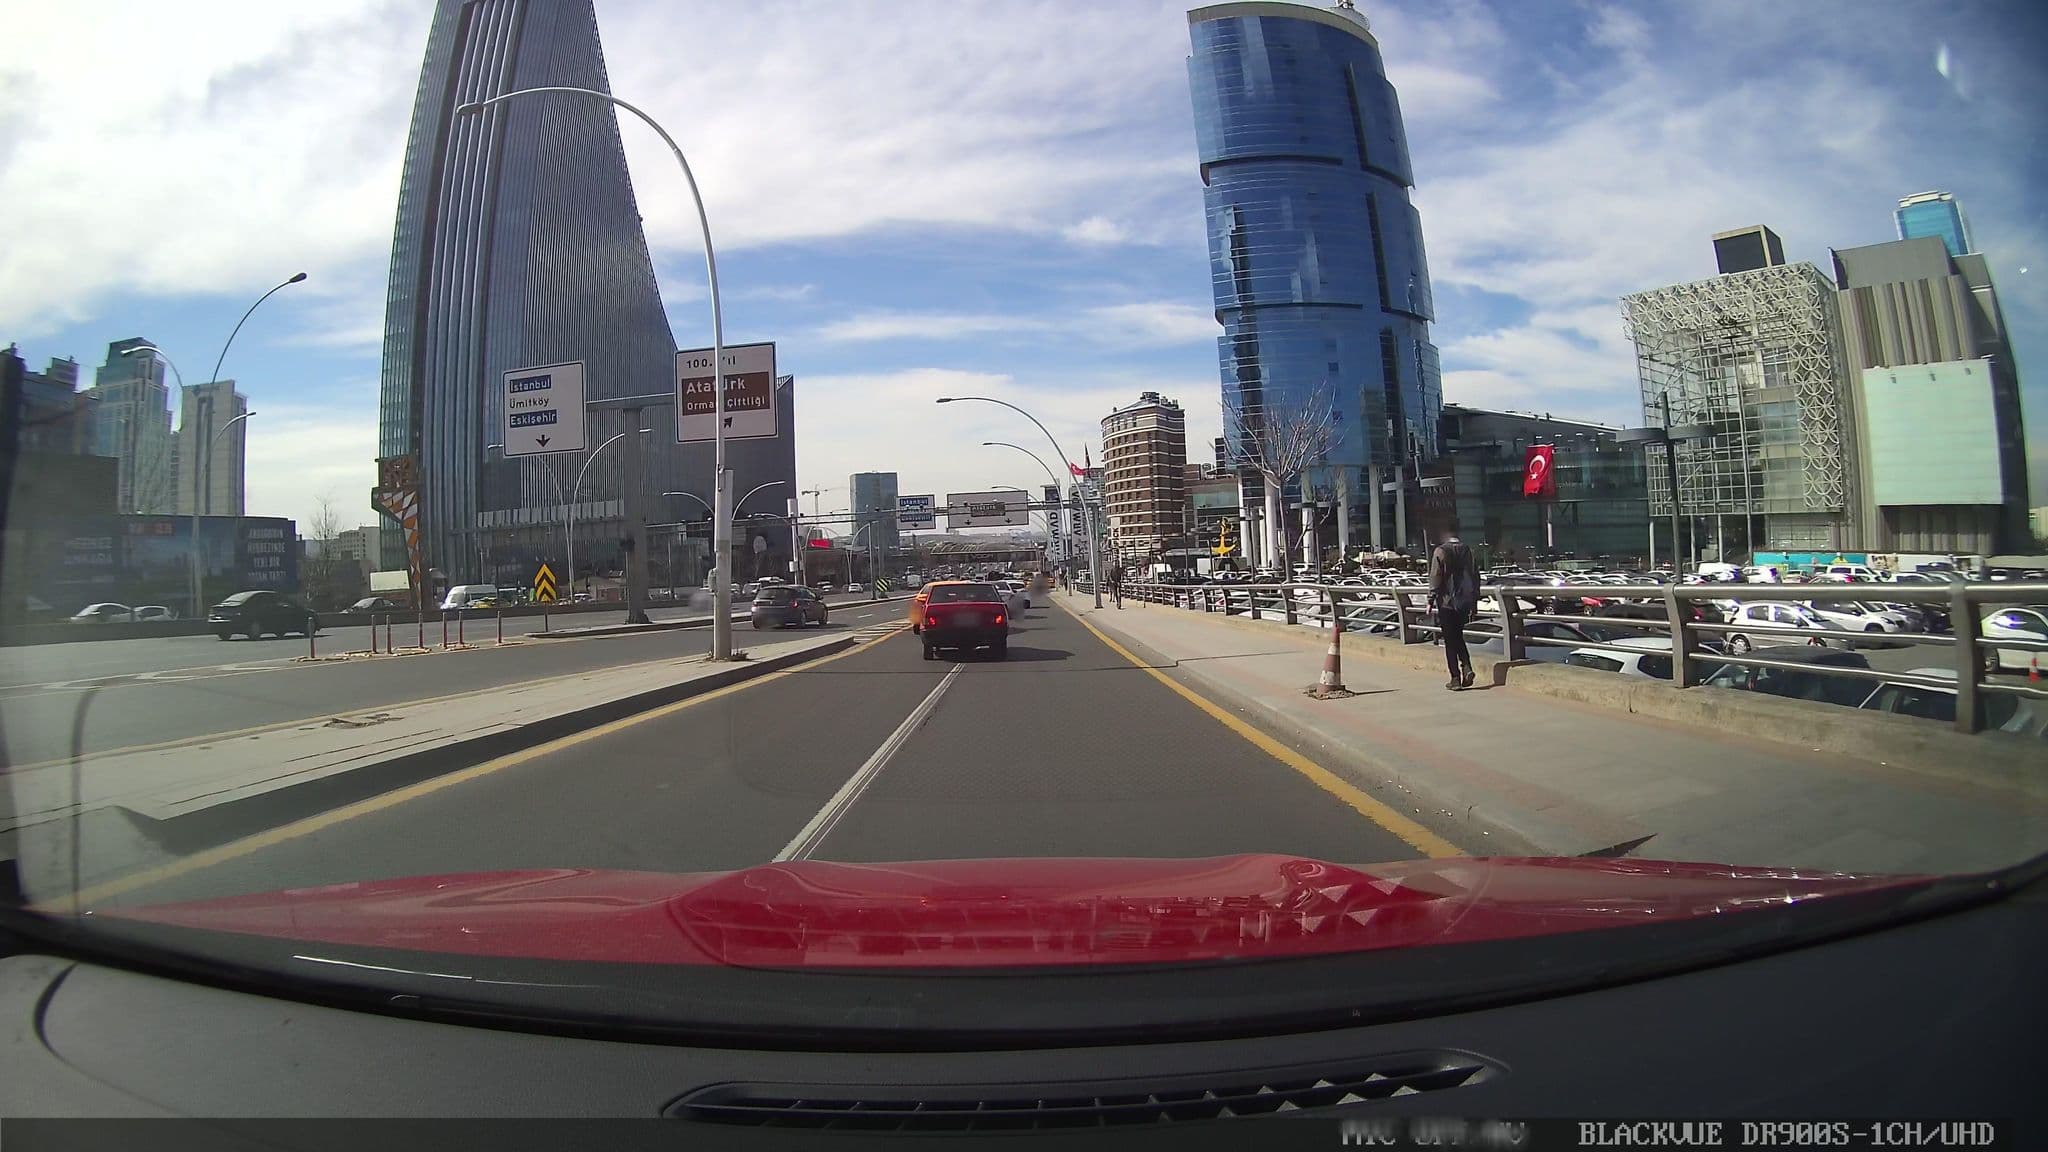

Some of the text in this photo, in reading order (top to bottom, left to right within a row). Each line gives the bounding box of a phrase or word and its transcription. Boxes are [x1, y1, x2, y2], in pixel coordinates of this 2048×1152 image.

[686, 358, 713, 369] 100.
[510, 378, 550, 393] İstanbul
[509, 396, 549, 409] Ümitköy
[687, 395, 765, 410] Orma Çiftliği
[510, 412, 556, 426] Eskişehir
[1049, 511, 1060, 556] ARMAD
